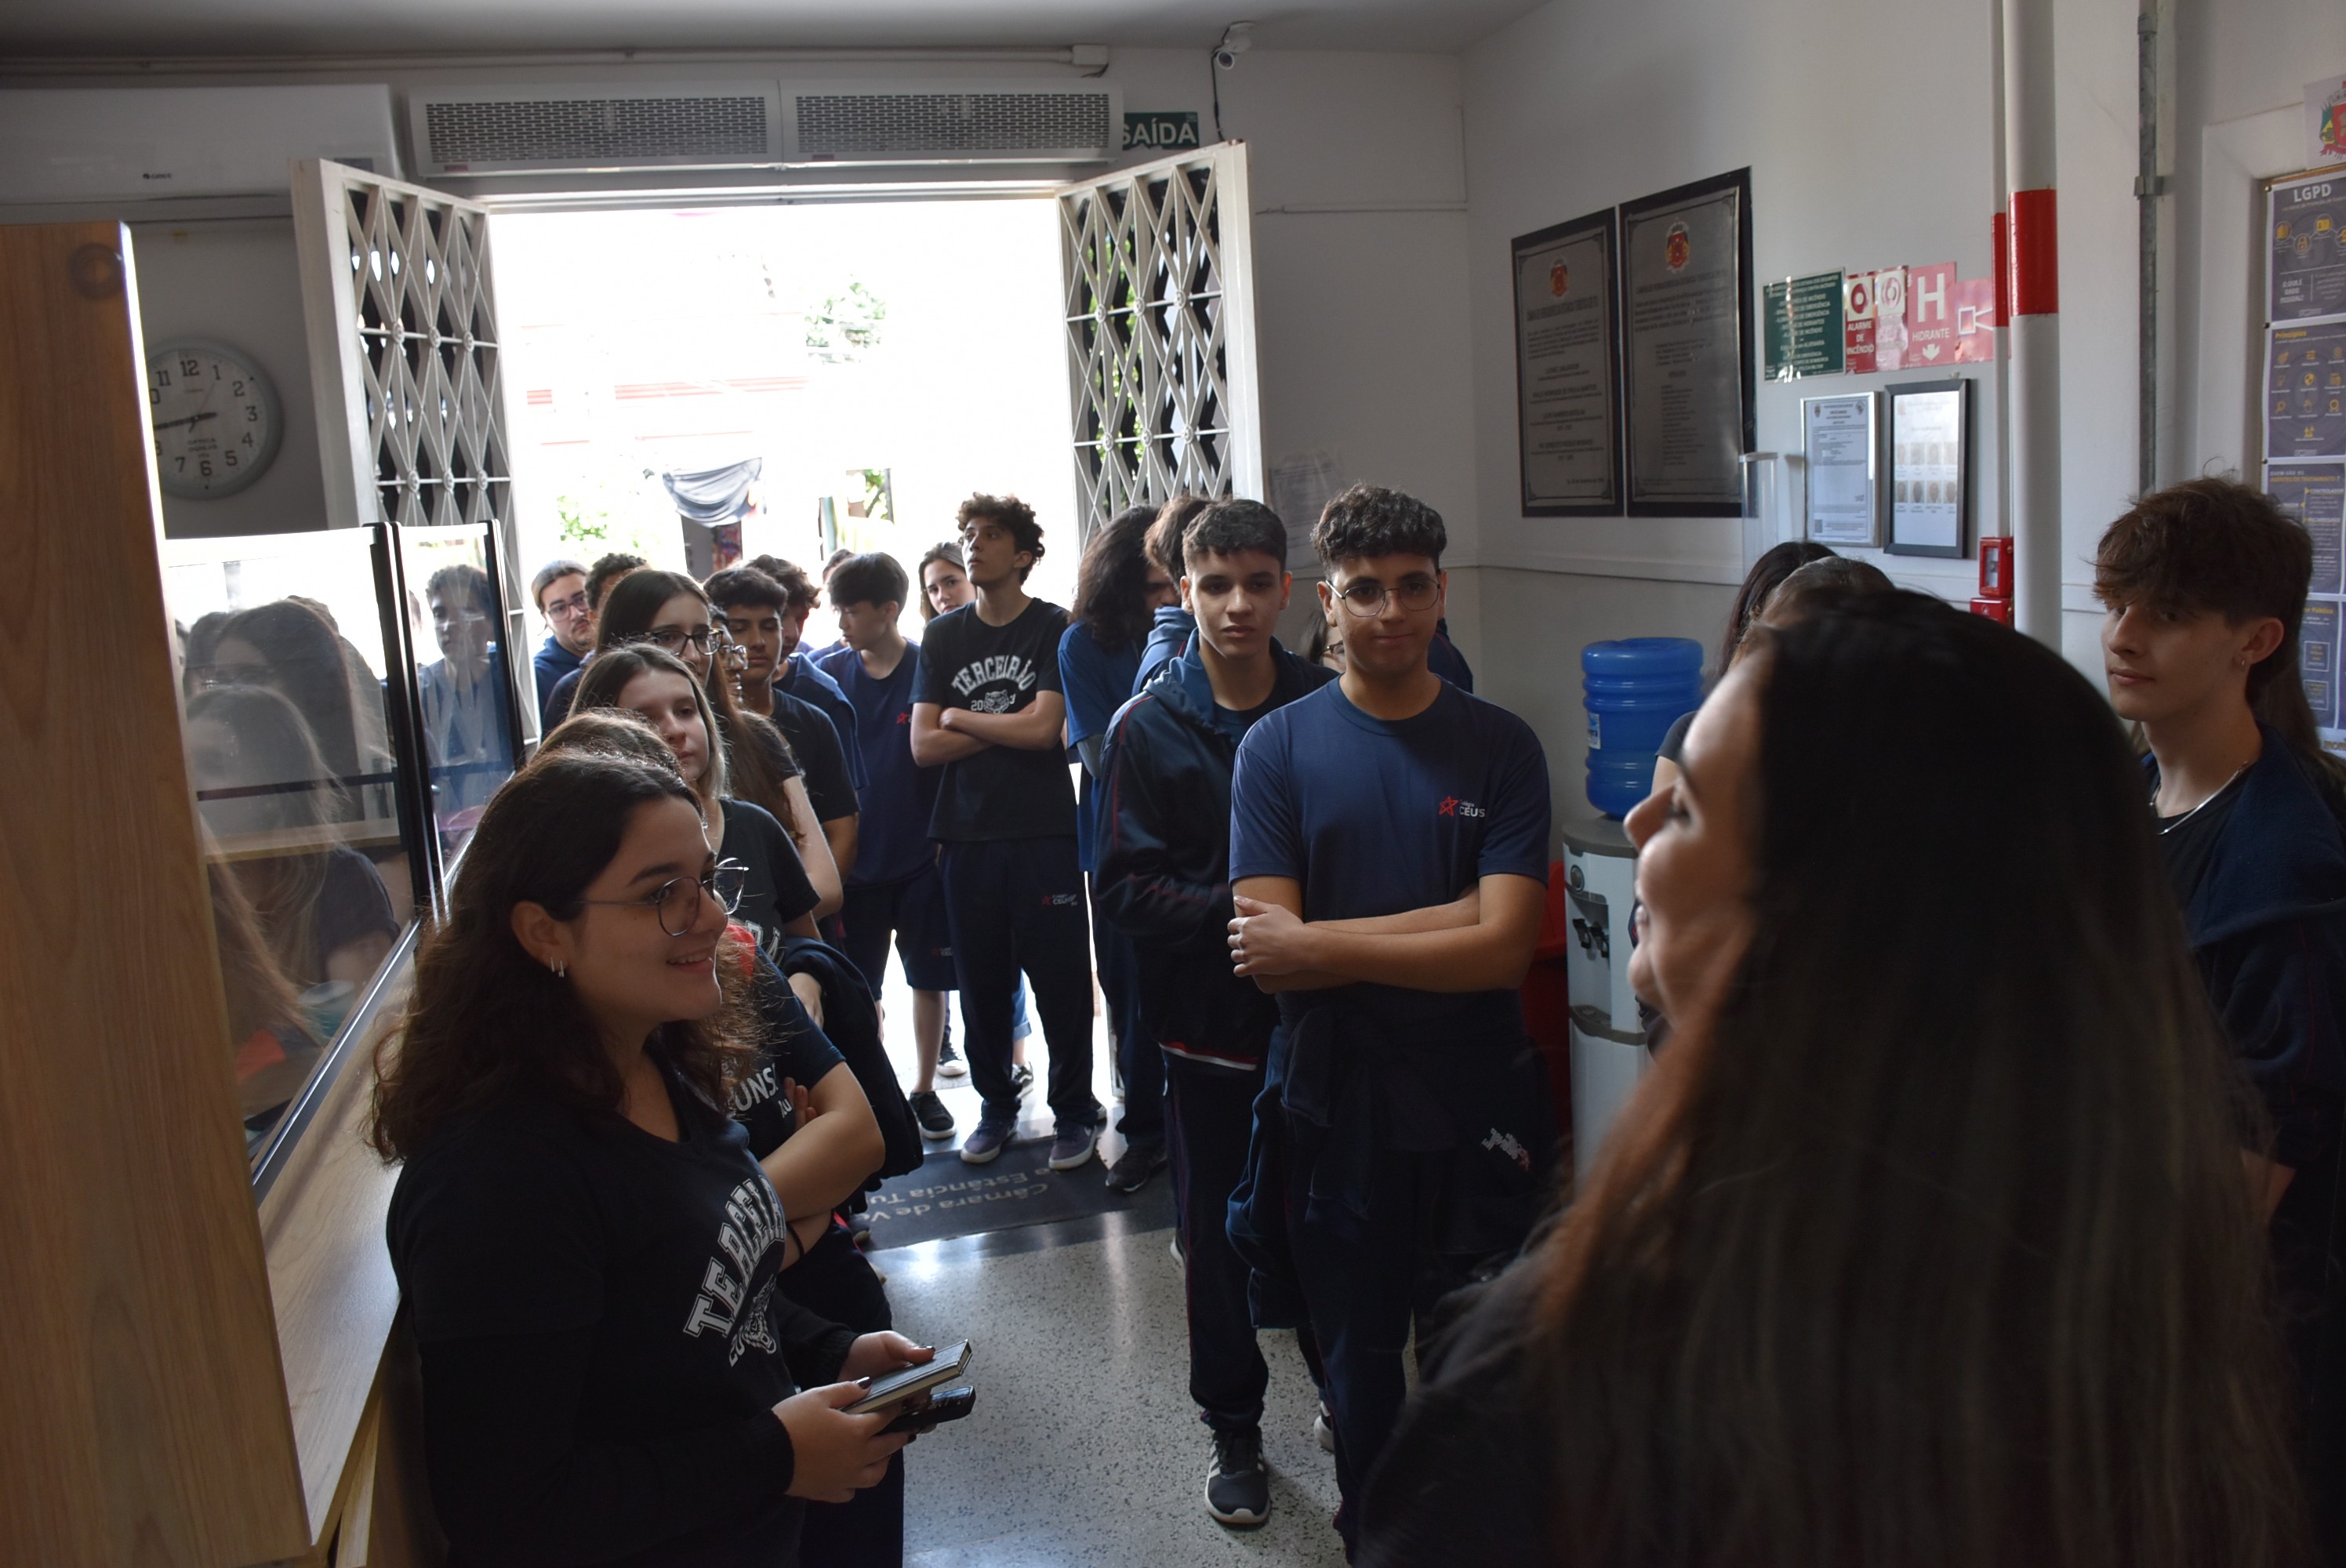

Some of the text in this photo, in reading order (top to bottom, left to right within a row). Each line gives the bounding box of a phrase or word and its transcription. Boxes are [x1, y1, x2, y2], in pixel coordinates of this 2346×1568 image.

[1123, 118, 1197, 145] SAÍDA
[2293, 183, 2332, 203] LGPD
[1917, 272, 1945, 323] H
[1847, 320, 1873, 332] ALARME
[1912, 327, 1951, 342] HIDRANTE
[1856, 333, 1865, 343] DE
[1847, 343, 1876, 355] INCÊNDIO
[180, 360, 200, 377] 12
[212, 364, 221, 381] 1
[157, 370, 171, 387] 11
[233, 380, 245, 397] 2
[245, 405, 258, 422] 3
[242, 432, 254, 448] 4
[175, 456, 186, 473] 7
[224, 450, 238, 466] 5
[199, 460, 212, 477] 6
[970, 699, 983, 712] 20
[909, 1171, 1028, 1198] Estância
[856, 1183, 1049, 1223] Câmara de Ve
[866, 1192, 906, 1206] Tu
